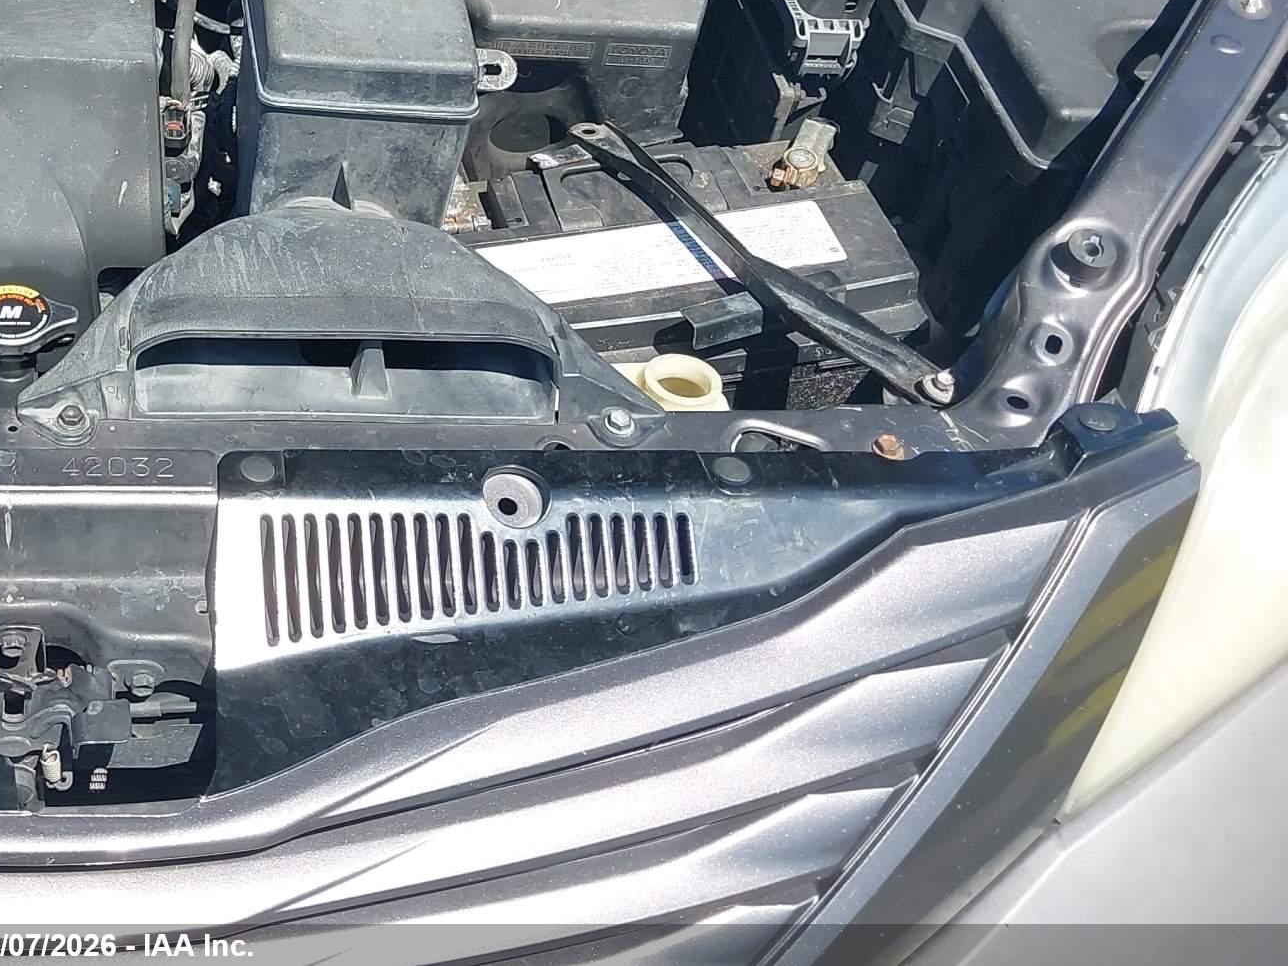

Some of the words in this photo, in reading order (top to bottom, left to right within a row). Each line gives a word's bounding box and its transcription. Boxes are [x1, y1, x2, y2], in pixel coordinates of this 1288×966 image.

[608, 46, 666, 57] TOYOTA
[0, 305, 23, 319] M
[62, 456, 175, 478] 42032
